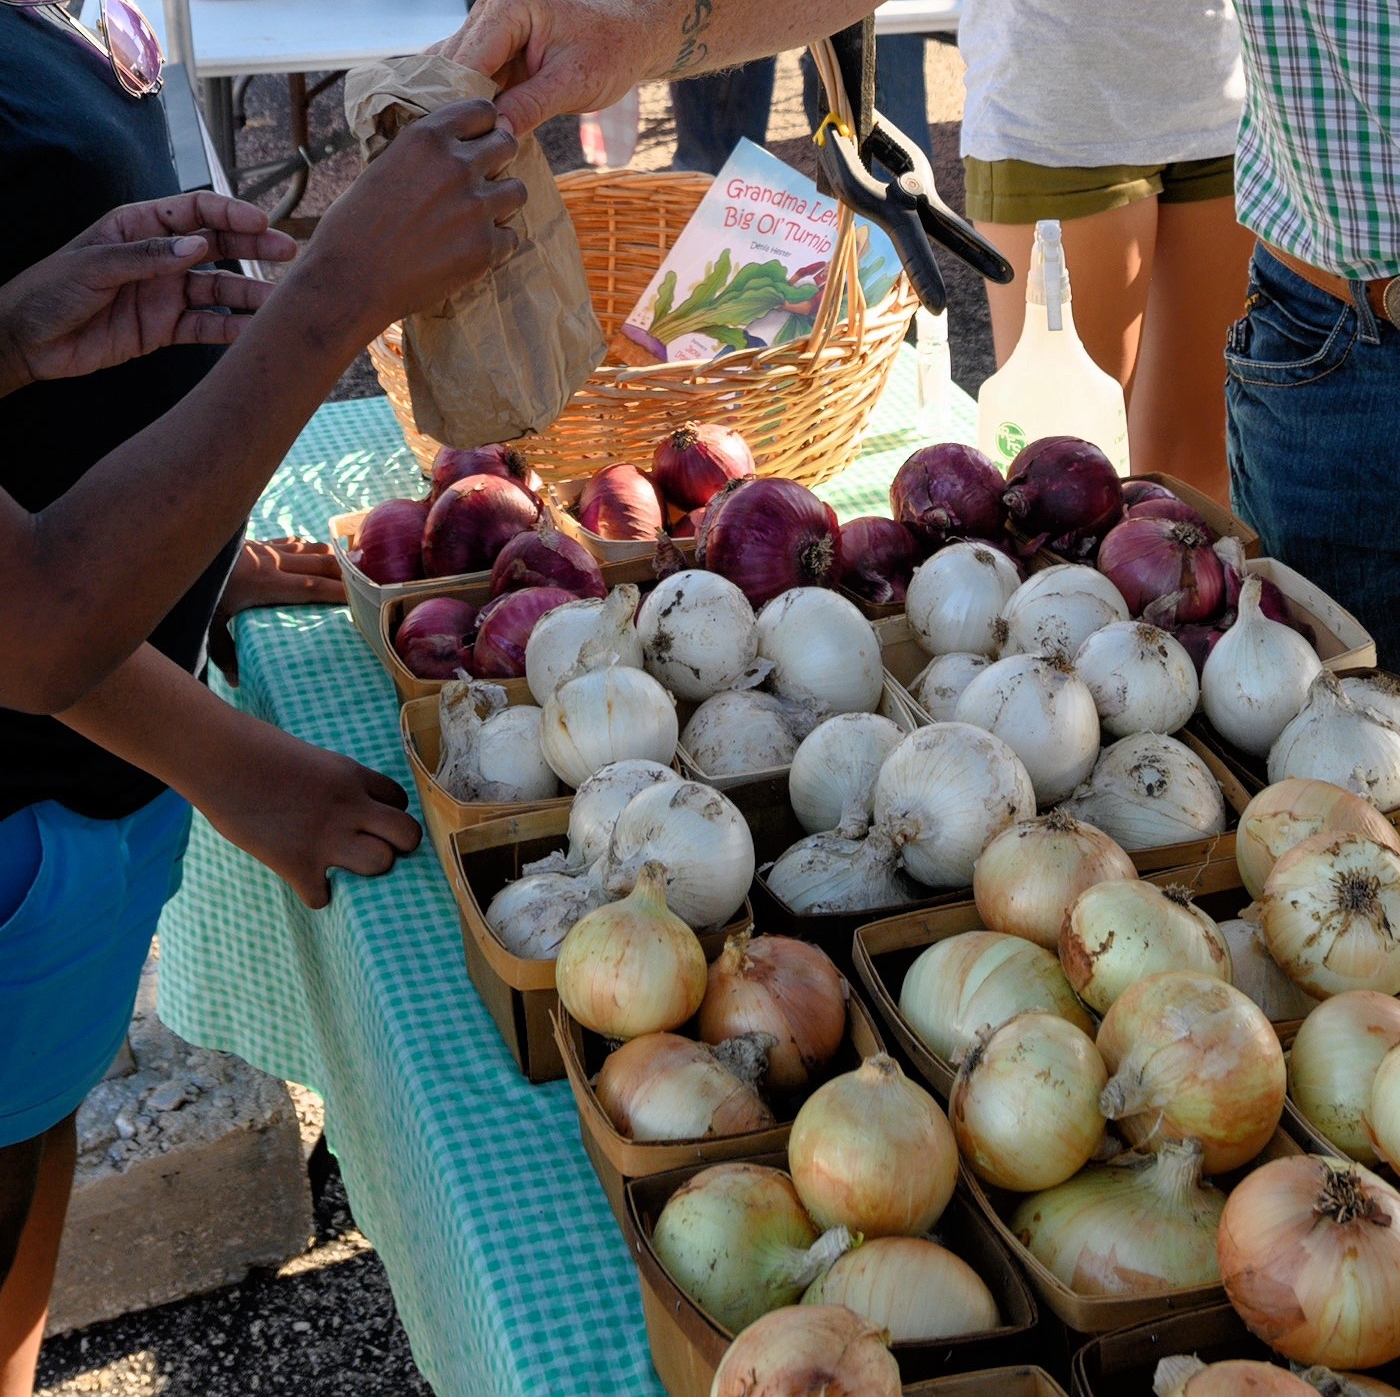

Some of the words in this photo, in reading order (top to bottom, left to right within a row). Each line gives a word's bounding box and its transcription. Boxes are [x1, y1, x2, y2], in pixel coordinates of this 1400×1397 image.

[727, 178, 807, 214] Grandma
[807, 201, 839, 230] Len
[724, 206, 756, 230] Big
[784, 221, 833, 254] Turnip
